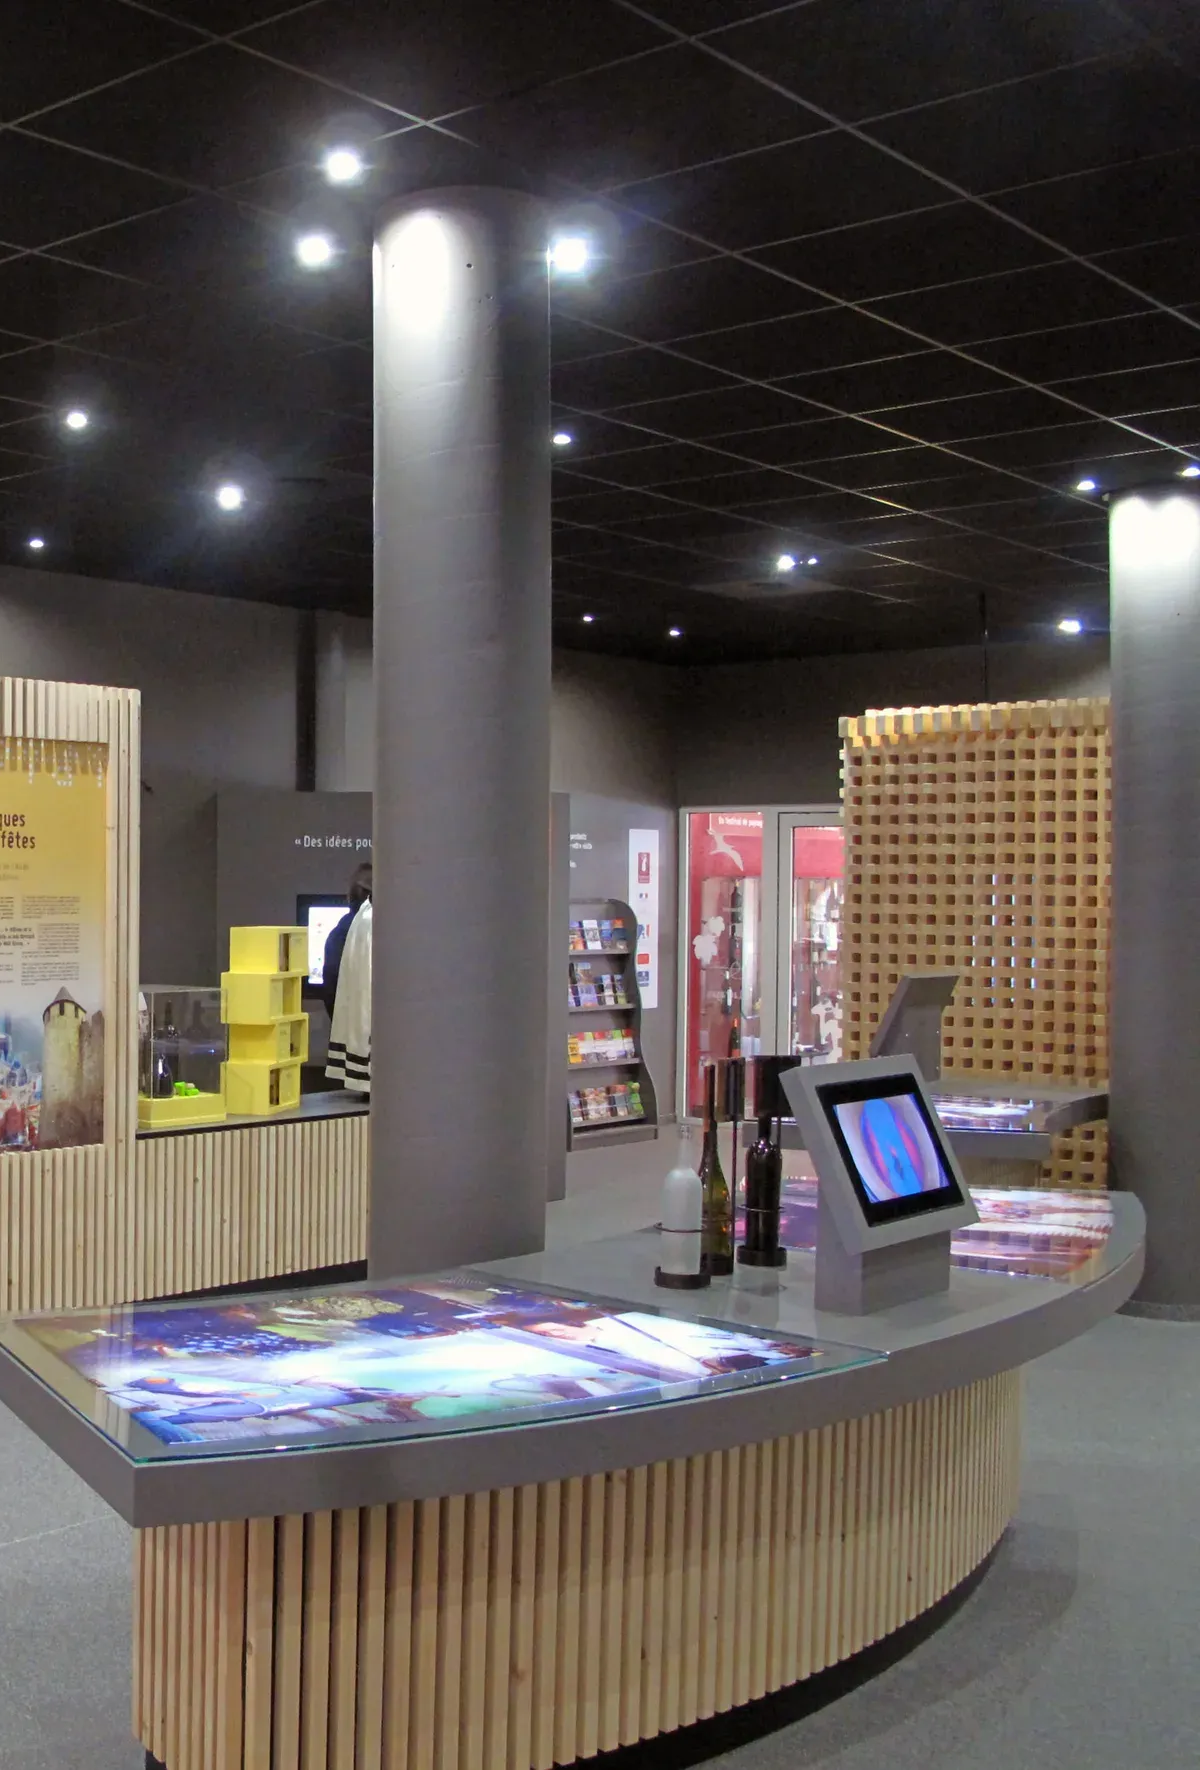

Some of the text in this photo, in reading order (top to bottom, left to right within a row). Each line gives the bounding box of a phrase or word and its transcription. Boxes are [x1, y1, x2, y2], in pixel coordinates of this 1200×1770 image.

[1, 830, 36, 849] fêtes
[303, 834, 323, 848] Des
[325, 834, 353, 848] idées
